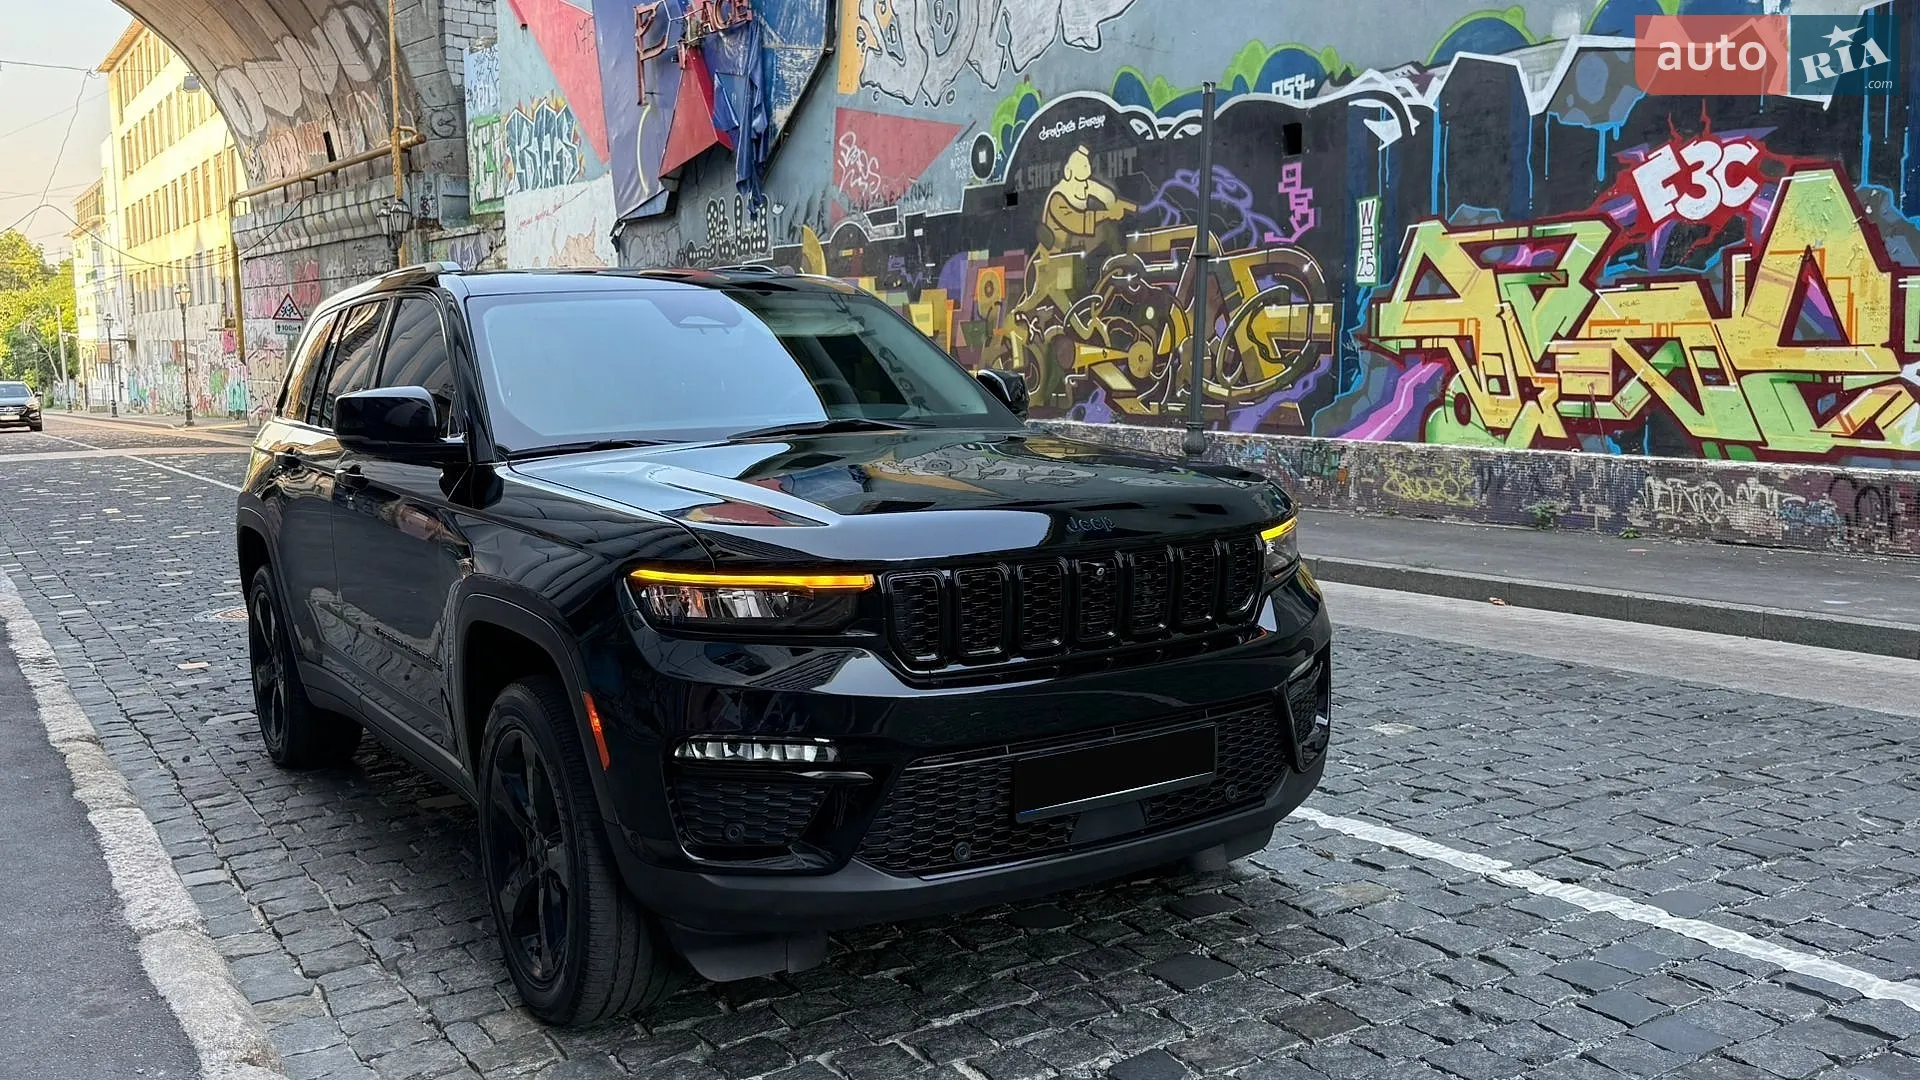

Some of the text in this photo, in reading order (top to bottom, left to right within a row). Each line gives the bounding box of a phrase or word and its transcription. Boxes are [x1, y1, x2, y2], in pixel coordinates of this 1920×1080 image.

[634, 0, 754, 105] PACE
[1106, 147, 1138, 179] HIT
[1631, 140, 1760, 224] E3C
[1066, 516, 1117, 533] Jeep
